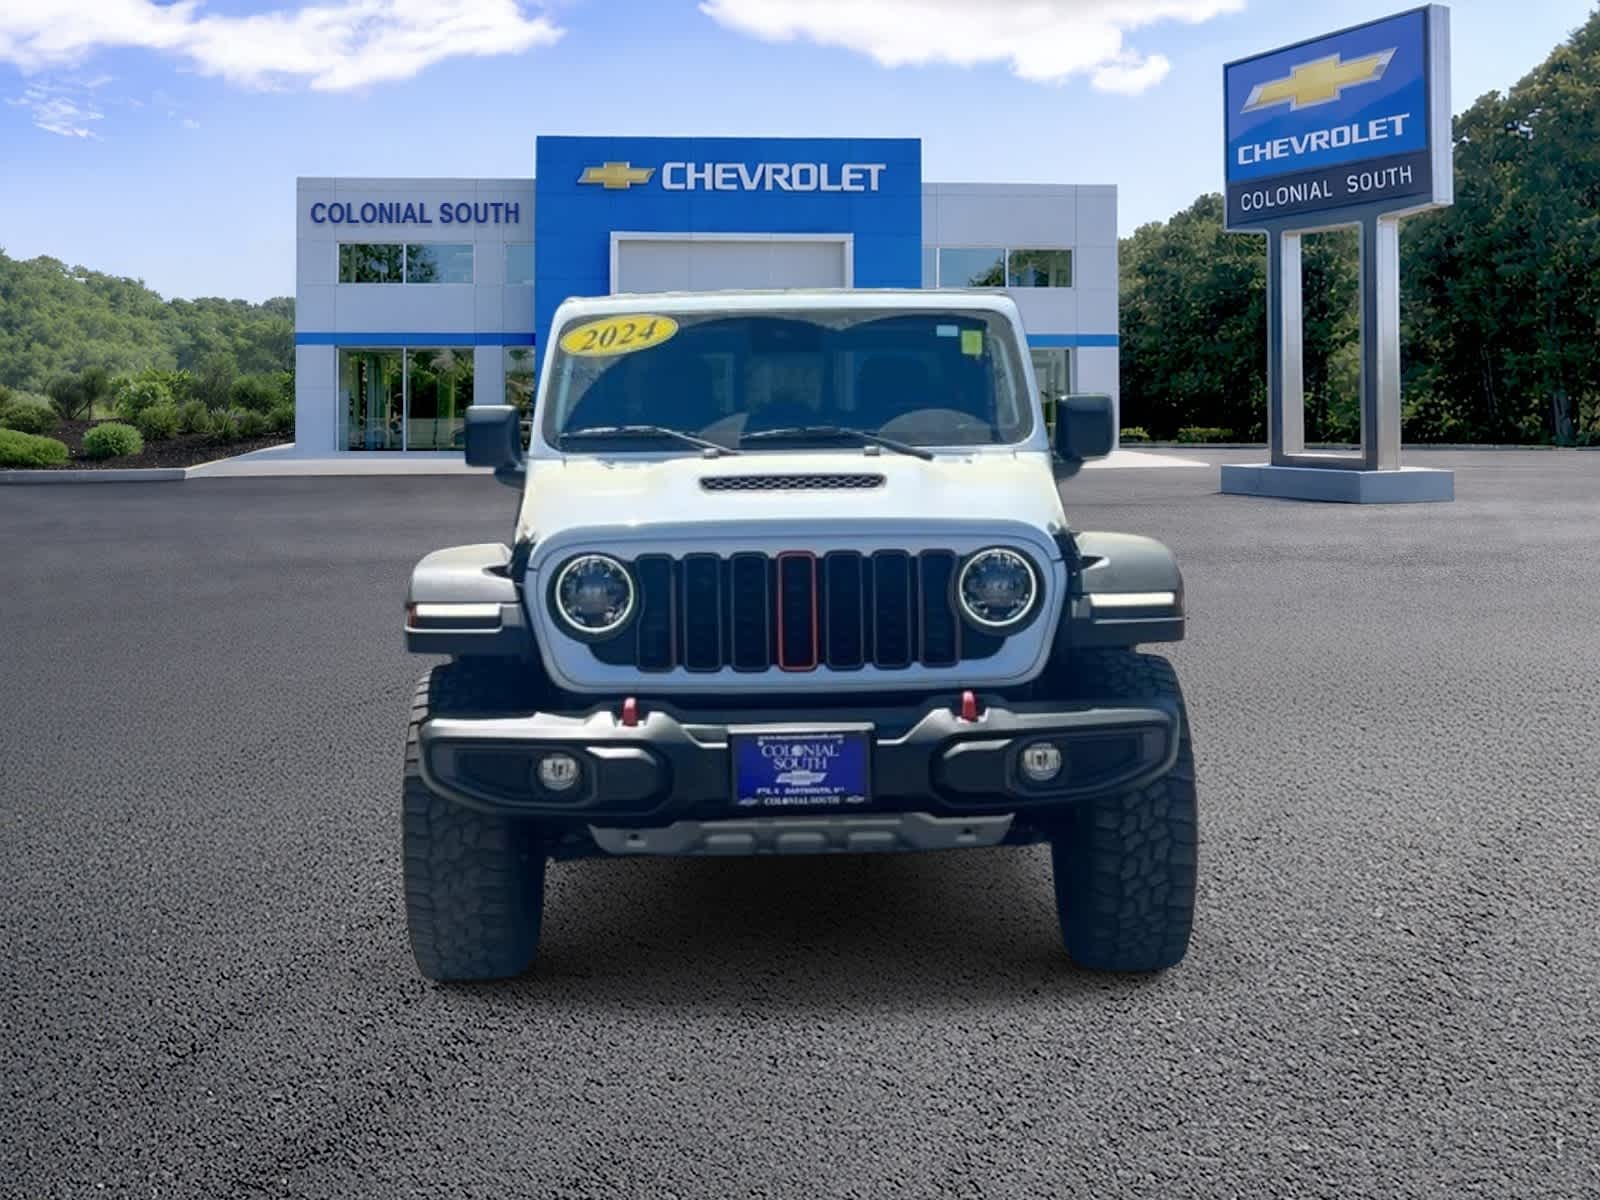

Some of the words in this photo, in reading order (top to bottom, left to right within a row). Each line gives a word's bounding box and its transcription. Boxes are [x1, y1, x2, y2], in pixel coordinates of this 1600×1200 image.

[1238, 113, 1410, 165] CHEVROLET
[662, 162, 887, 192] CHEVROLET
[1241, 180, 1333, 211] COLONIAL
[1347, 165, 1412, 193] SOUTH
[310, 202, 433, 224] COLONIAL
[439, 202, 520, 224] SOUTH
[582, 319, 658, 351] 2024
[761, 744, 840, 757] COLONIAL
[774, 757, 827, 769] SOUTH
